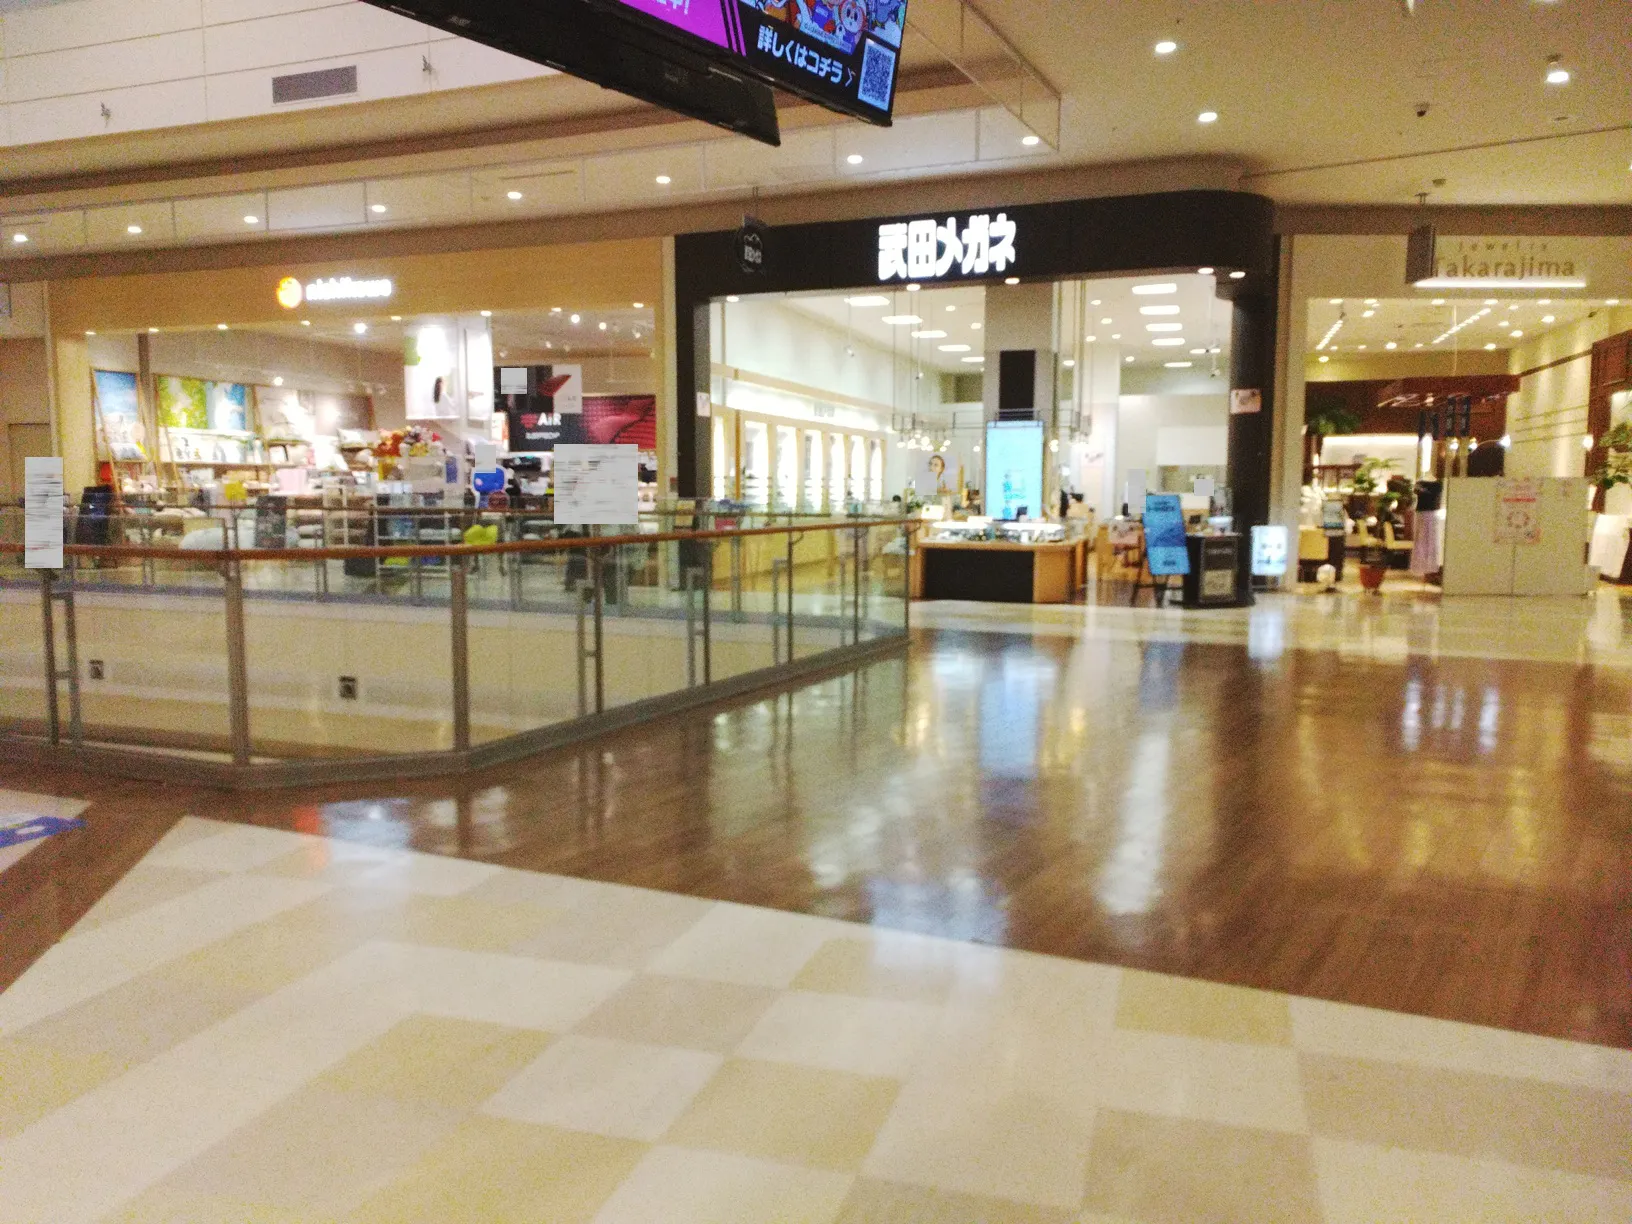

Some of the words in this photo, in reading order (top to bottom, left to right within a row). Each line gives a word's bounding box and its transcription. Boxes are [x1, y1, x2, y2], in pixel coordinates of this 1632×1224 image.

[757, 25, 843, 84] 詳しくはコチラ
[878, 213, 1017, 281] 武田メガネ
